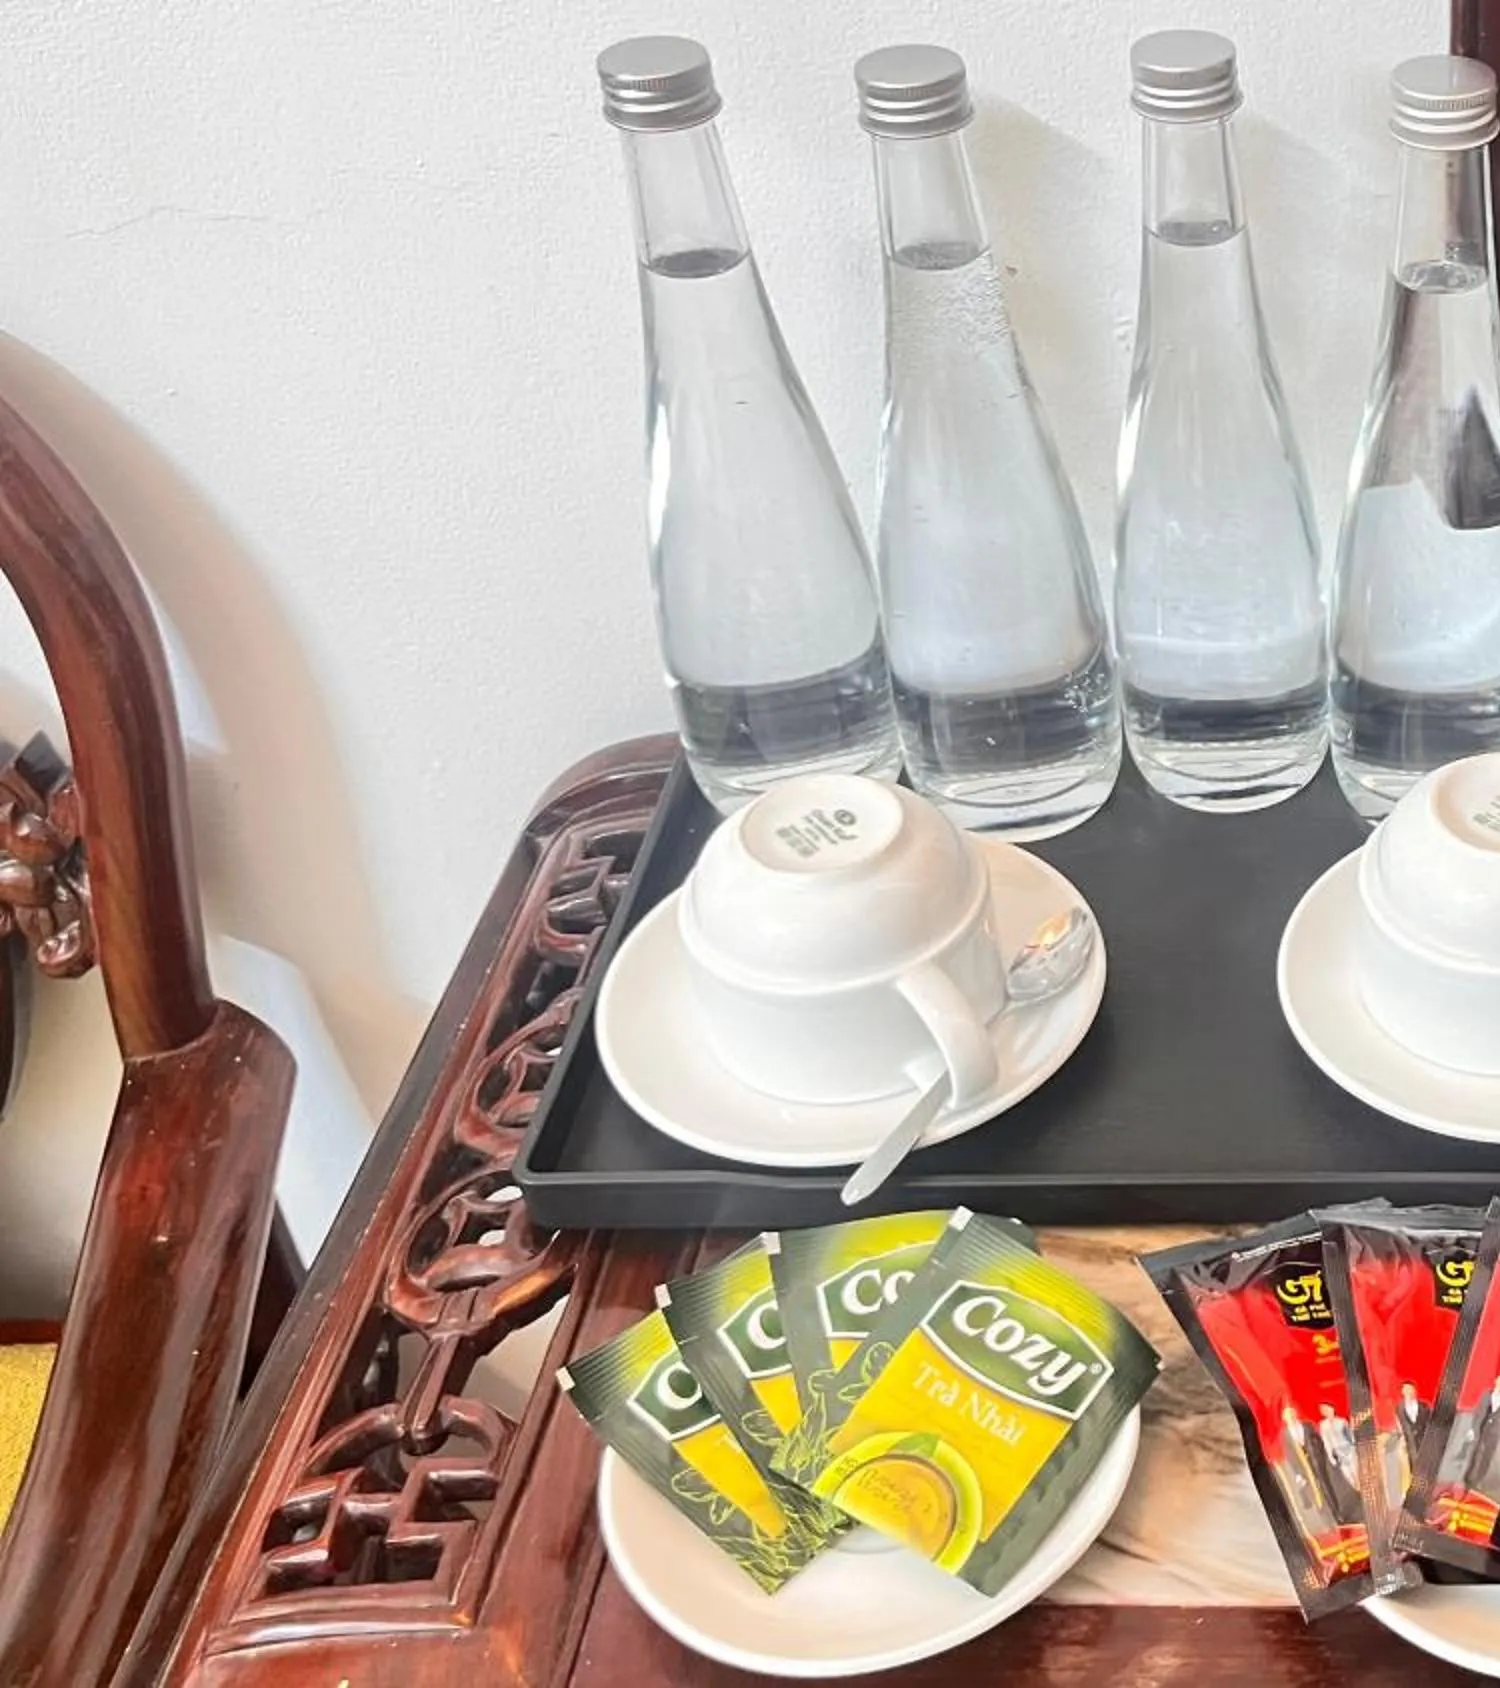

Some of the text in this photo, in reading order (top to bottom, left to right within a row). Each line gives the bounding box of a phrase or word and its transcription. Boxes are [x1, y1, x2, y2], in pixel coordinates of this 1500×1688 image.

[841, 1269, 916, 1315] Co
[1276, 1270, 1322, 1304] G7
[1436, 1261, 1474, 1286] G
[953, 1296, 1088, 1395] Cozy
